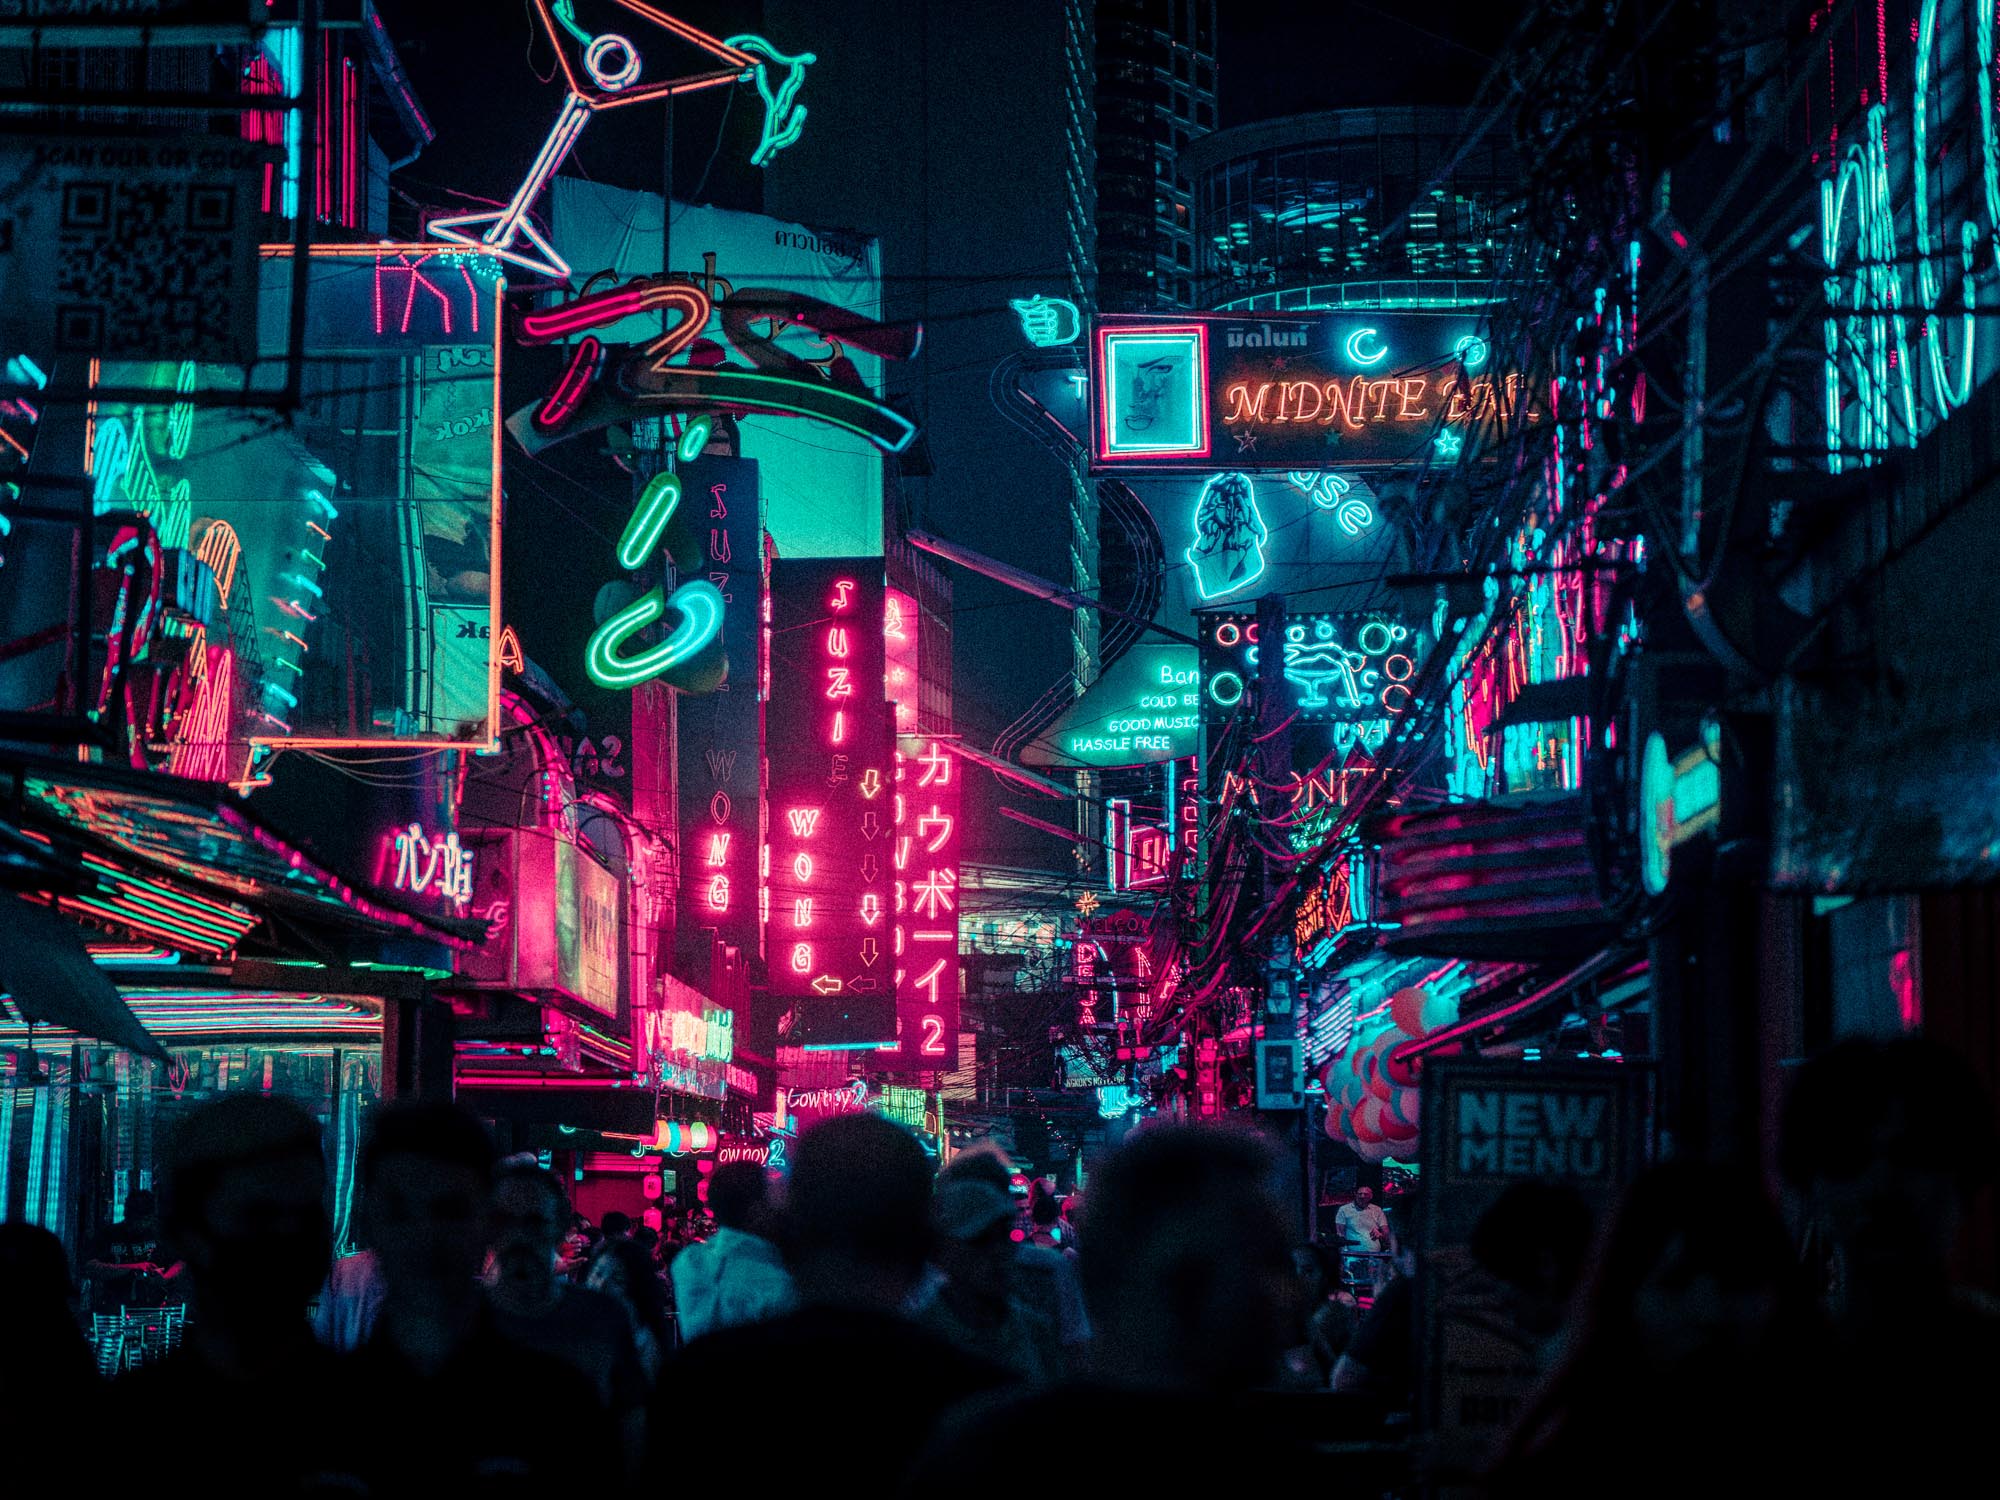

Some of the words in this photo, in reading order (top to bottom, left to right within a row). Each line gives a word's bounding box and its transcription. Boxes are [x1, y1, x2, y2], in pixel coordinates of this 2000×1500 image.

[1224, 375, 1429, 429] MIDNITE
[825, 579, 855, 788] SUZIE
[1141, 694, 1176, 708] COLD
[1073, 737, 1130, 751] HASSLE
[1134, 736, 1170, 749] FREE
[1109, 720, 1150, 733] GOOD
[1153, 715, 1199, 729] MUSIC
[786, 807, 820, 974] WONG
[1458, 1092, 1606, 1138] NEW
[1458, 1138, 1605, 1176] MENU
